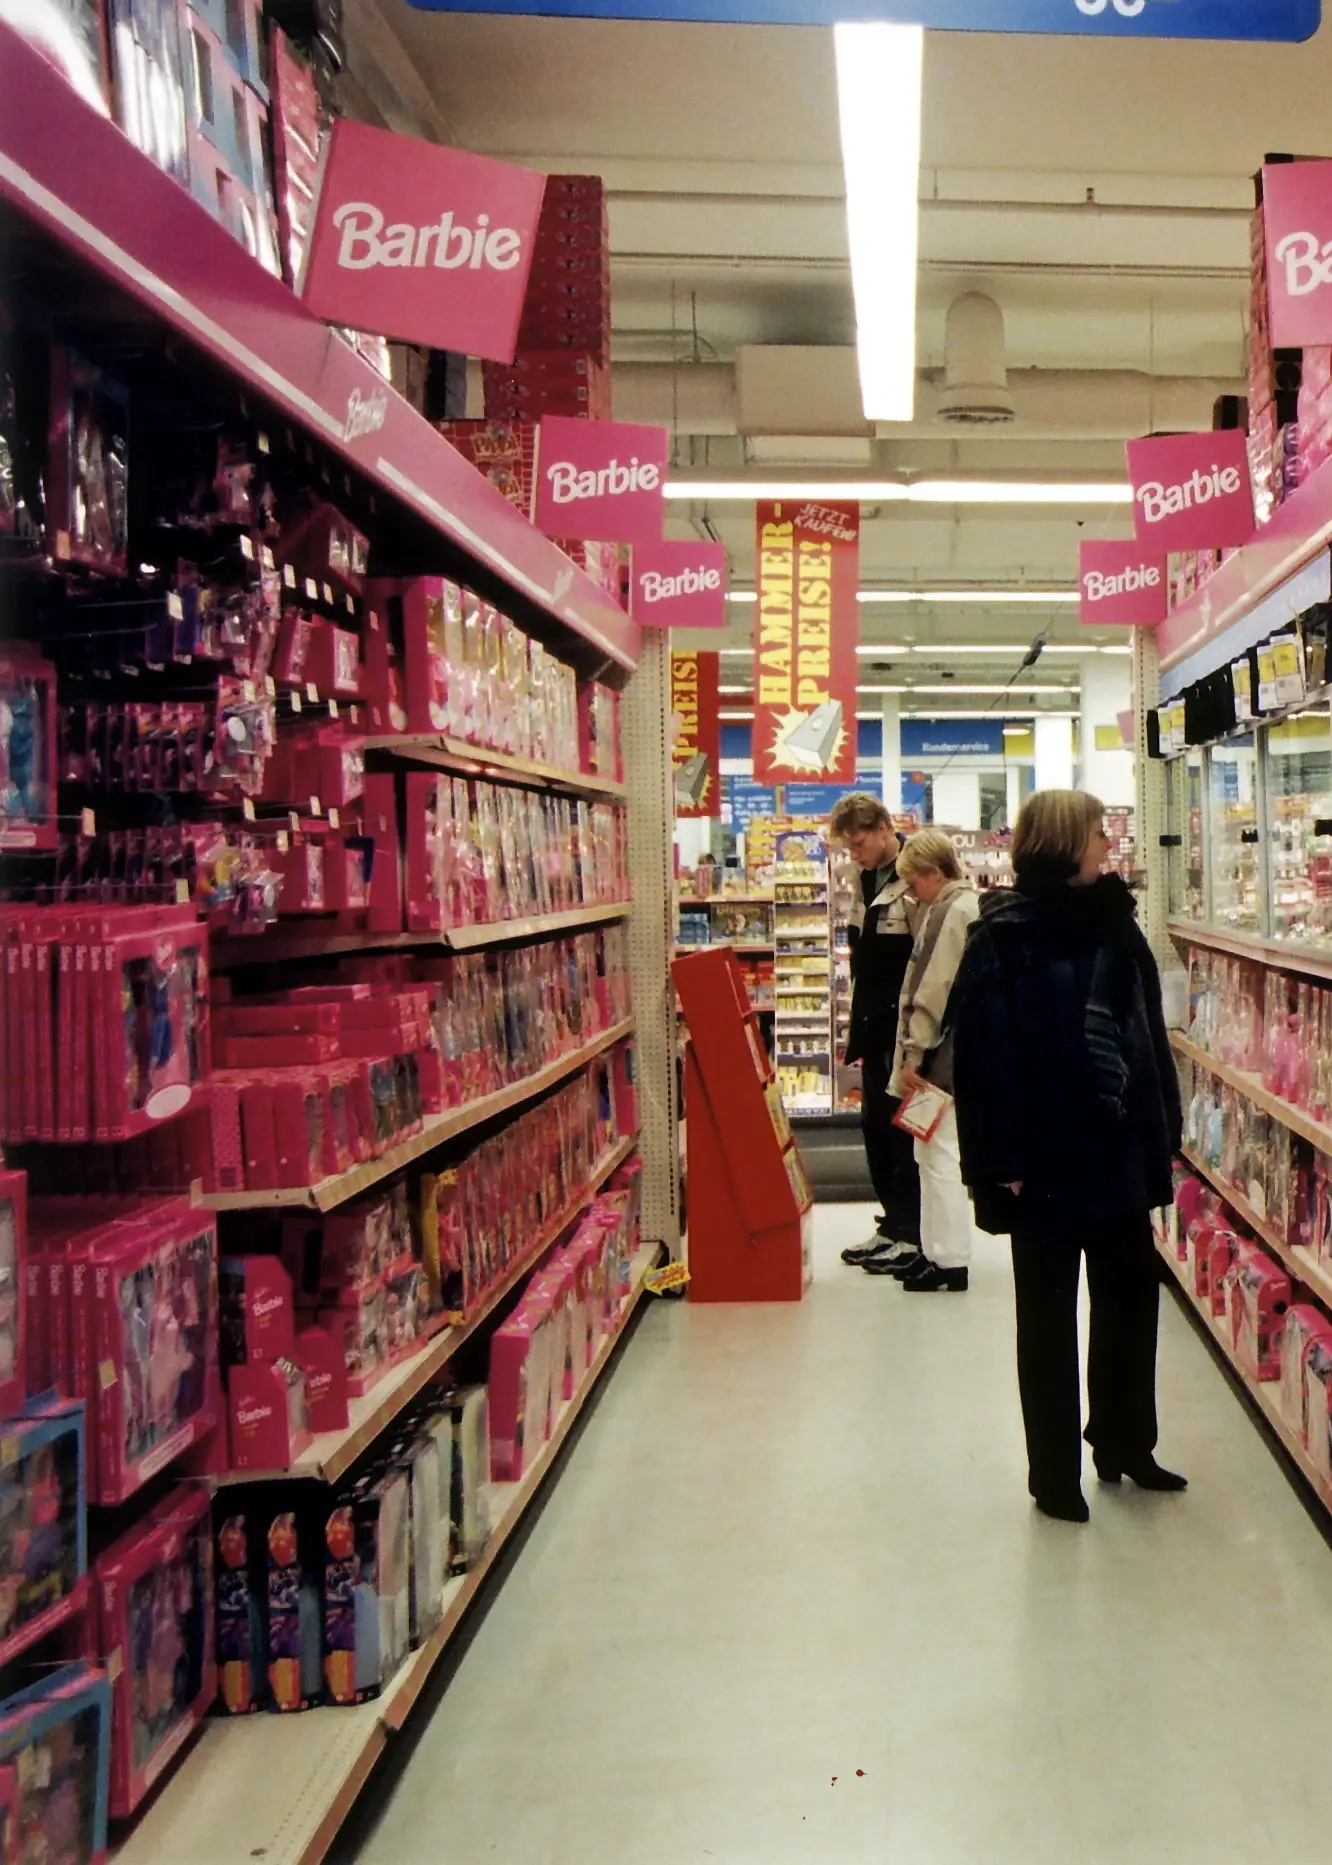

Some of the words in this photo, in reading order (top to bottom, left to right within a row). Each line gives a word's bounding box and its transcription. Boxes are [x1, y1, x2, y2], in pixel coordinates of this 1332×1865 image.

[333, 202, 521, 270] Barbie
[547, 458, 660, 503] Barbie
[1137, 465, 1241, 522] Barbie
[794, 516, 857, 541] KAUFEN!
[801, 504, 850, 527] JETZT
[640, 566, 721, 602] Barbie
[1083, 563, 1161, 601] Barbie
[797, 541, 832, 705] PREISE!
[673, 652, 698, 757] PREIS
